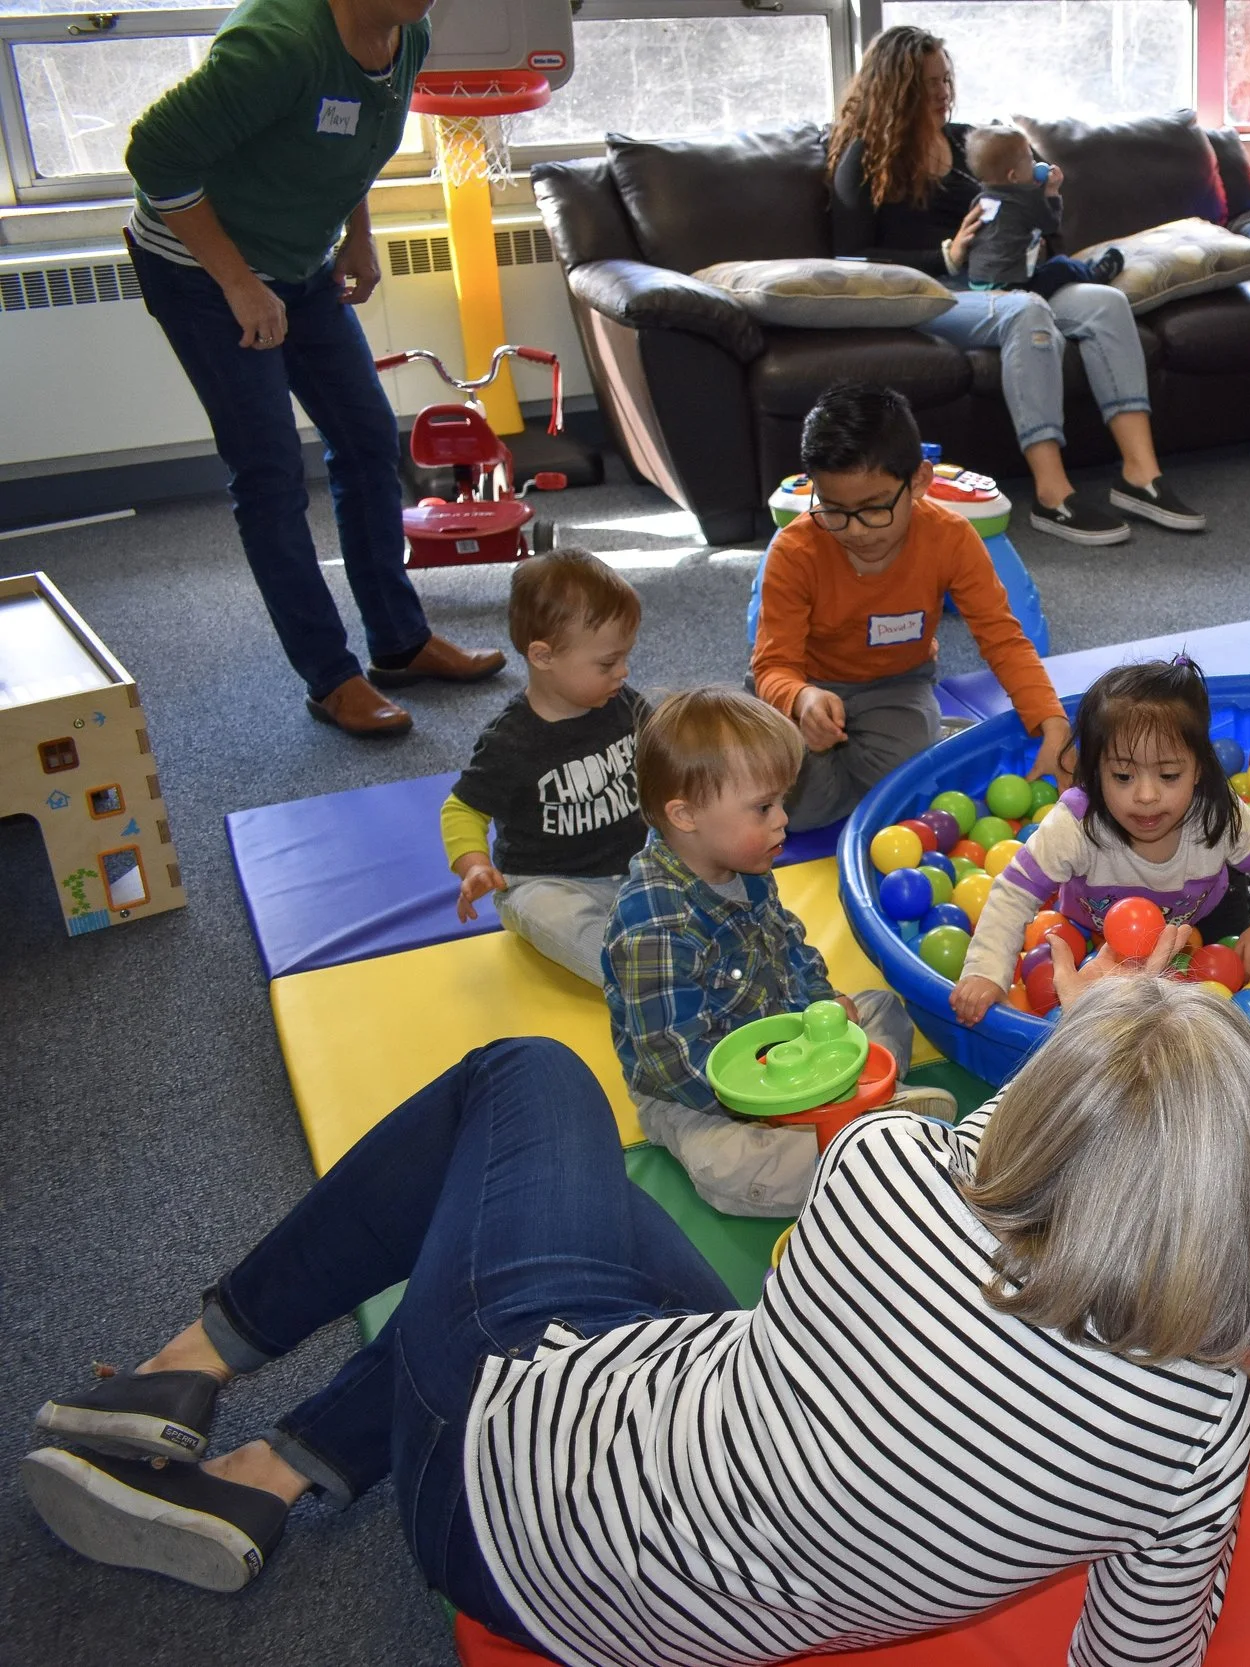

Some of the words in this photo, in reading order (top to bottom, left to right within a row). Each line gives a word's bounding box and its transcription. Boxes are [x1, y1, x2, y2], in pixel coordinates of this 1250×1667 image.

[320, 105, 351, 134] Mary
[877, 622, 906, 637] David
[537, 731, 638, 805] CHROMOSOM
[542, 768, 640, 837] ENHANC
[165, 1428, 198, 1447] SPERRY
